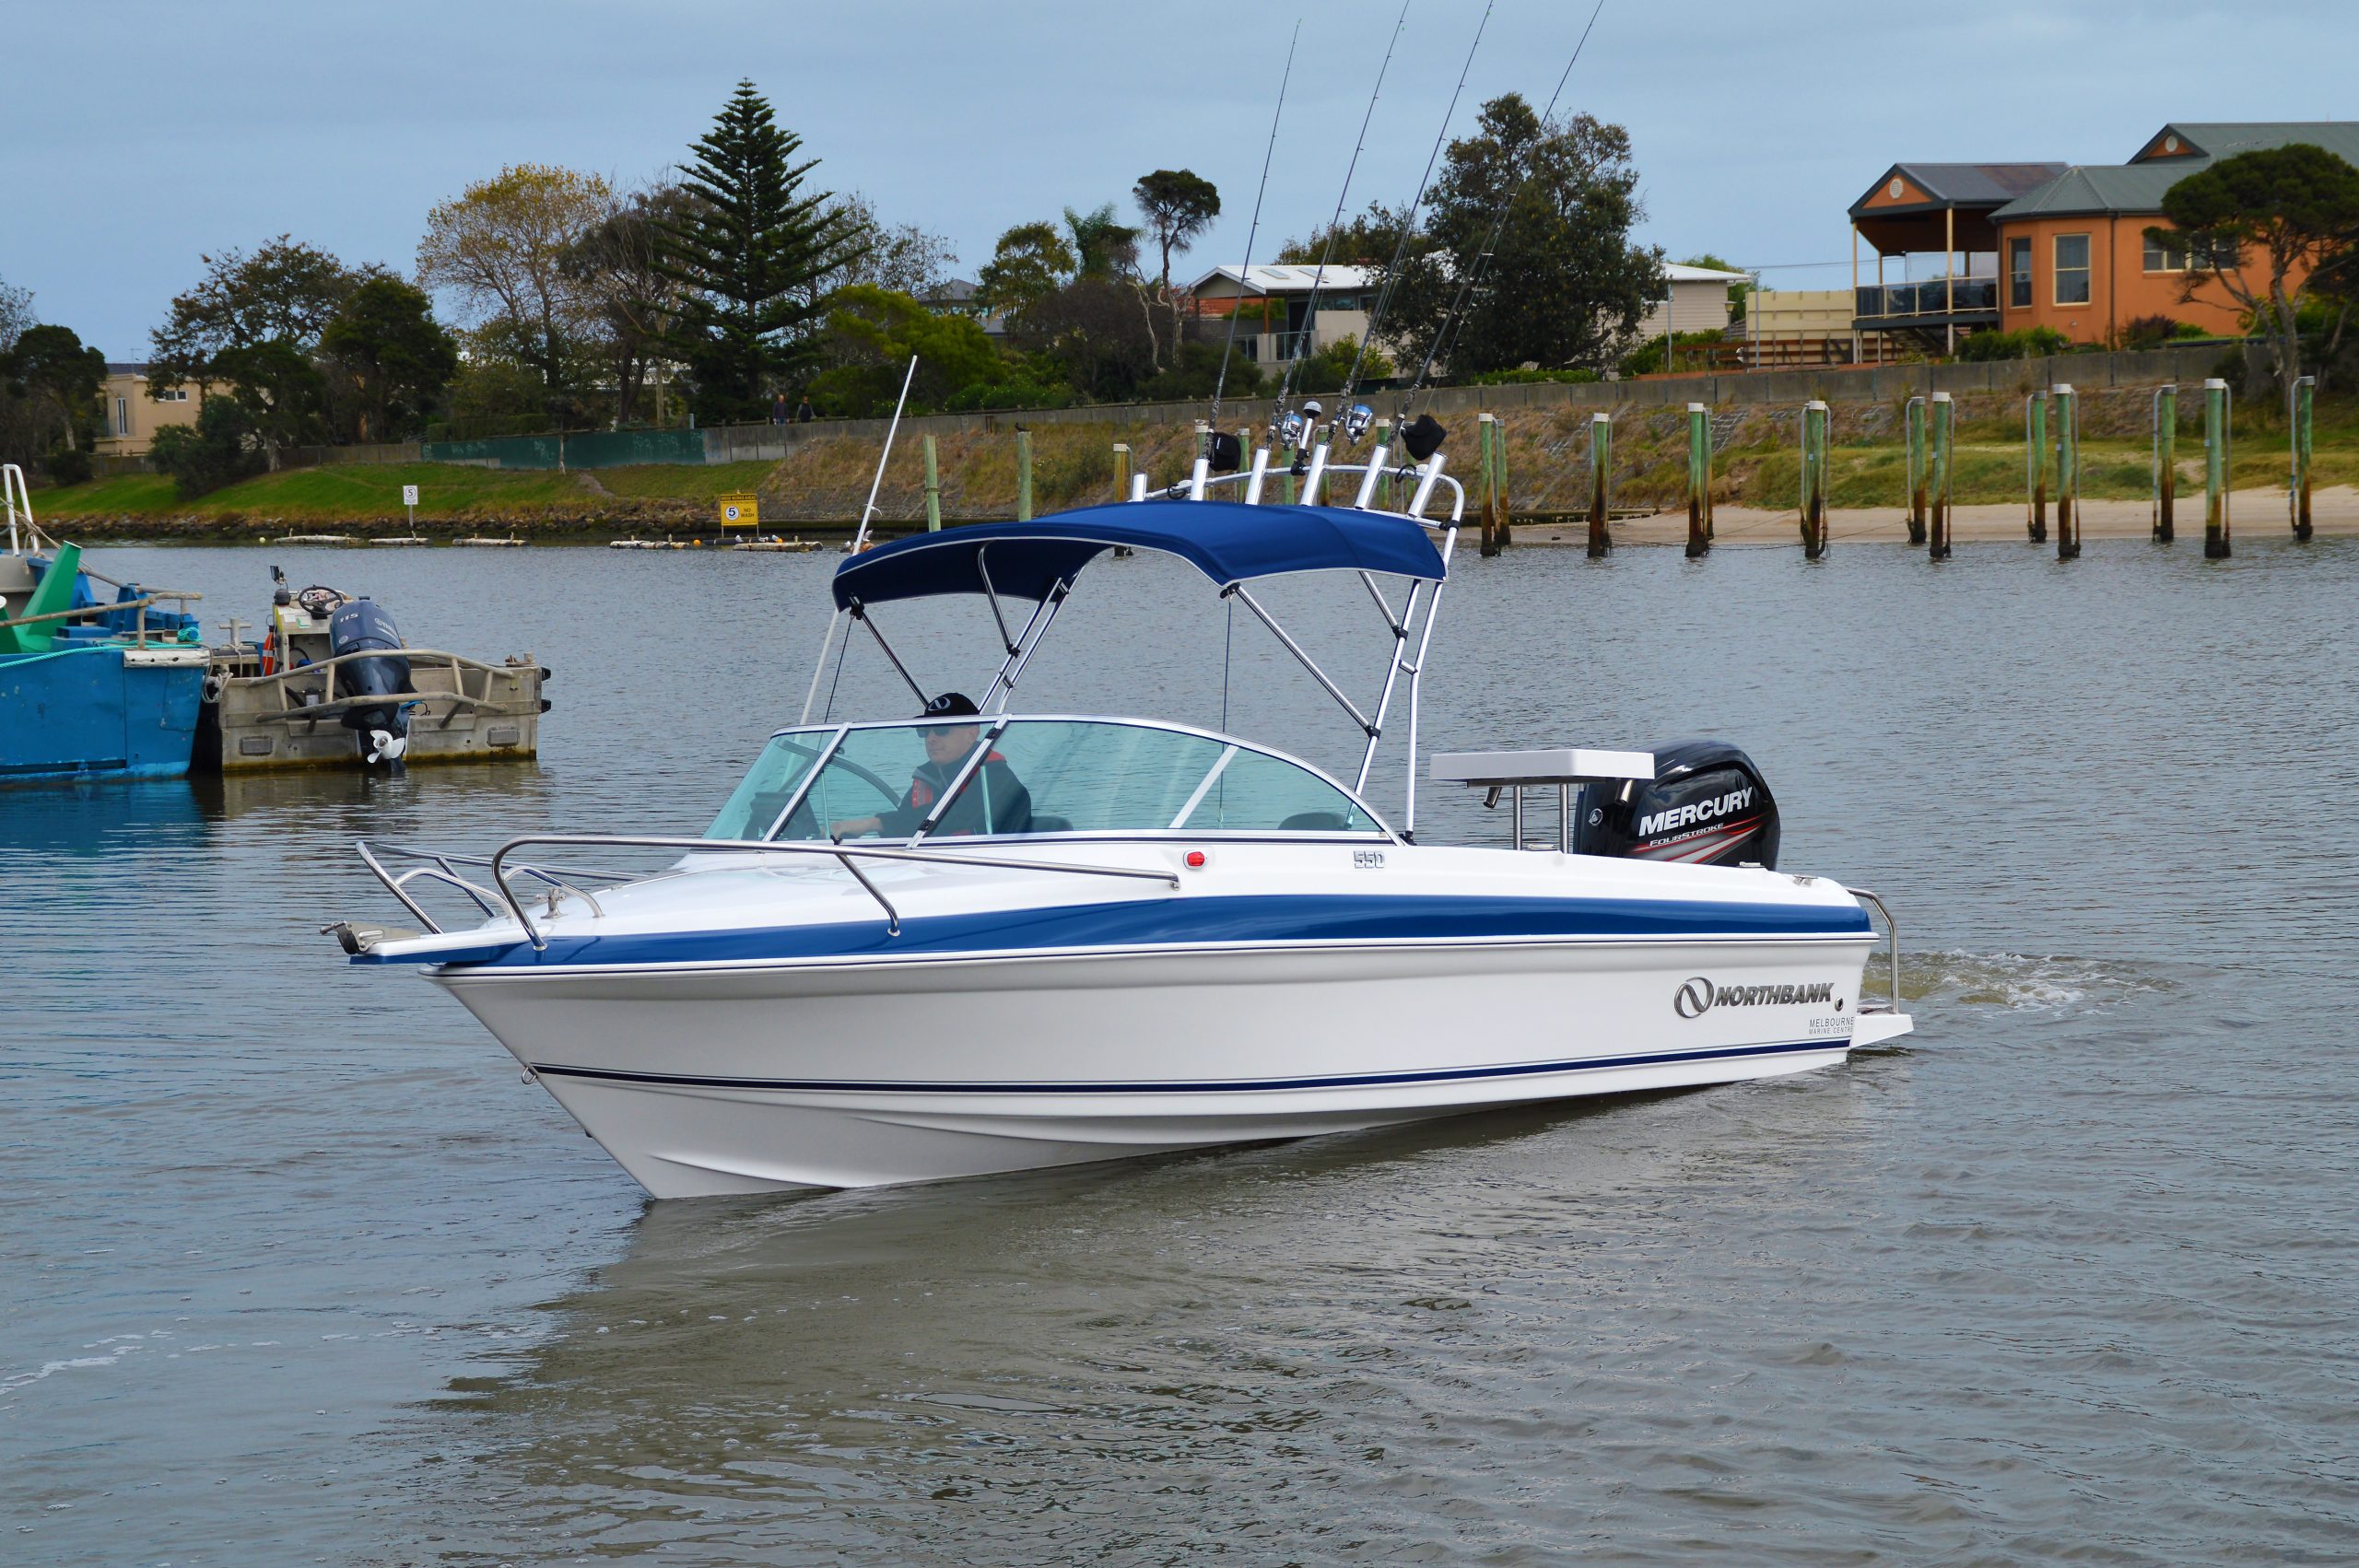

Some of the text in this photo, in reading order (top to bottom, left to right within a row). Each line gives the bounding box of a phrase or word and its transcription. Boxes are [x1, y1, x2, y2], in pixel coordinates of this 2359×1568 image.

[728, 508, 735, 516] 5
[340, 613, 358, 623] 115
[1638, 787, 1753, 837] MERCURY
[1649, 823, 1724, 847] FOURSTROKE
[1354, 850, 1385, 869] 550
[1714, 982, 1835, 1007] NORTHBANK
[1809, 1016, 1854, 1028] MELBOURNE
[1833, 1025, 1854, 1034] CENTRE
